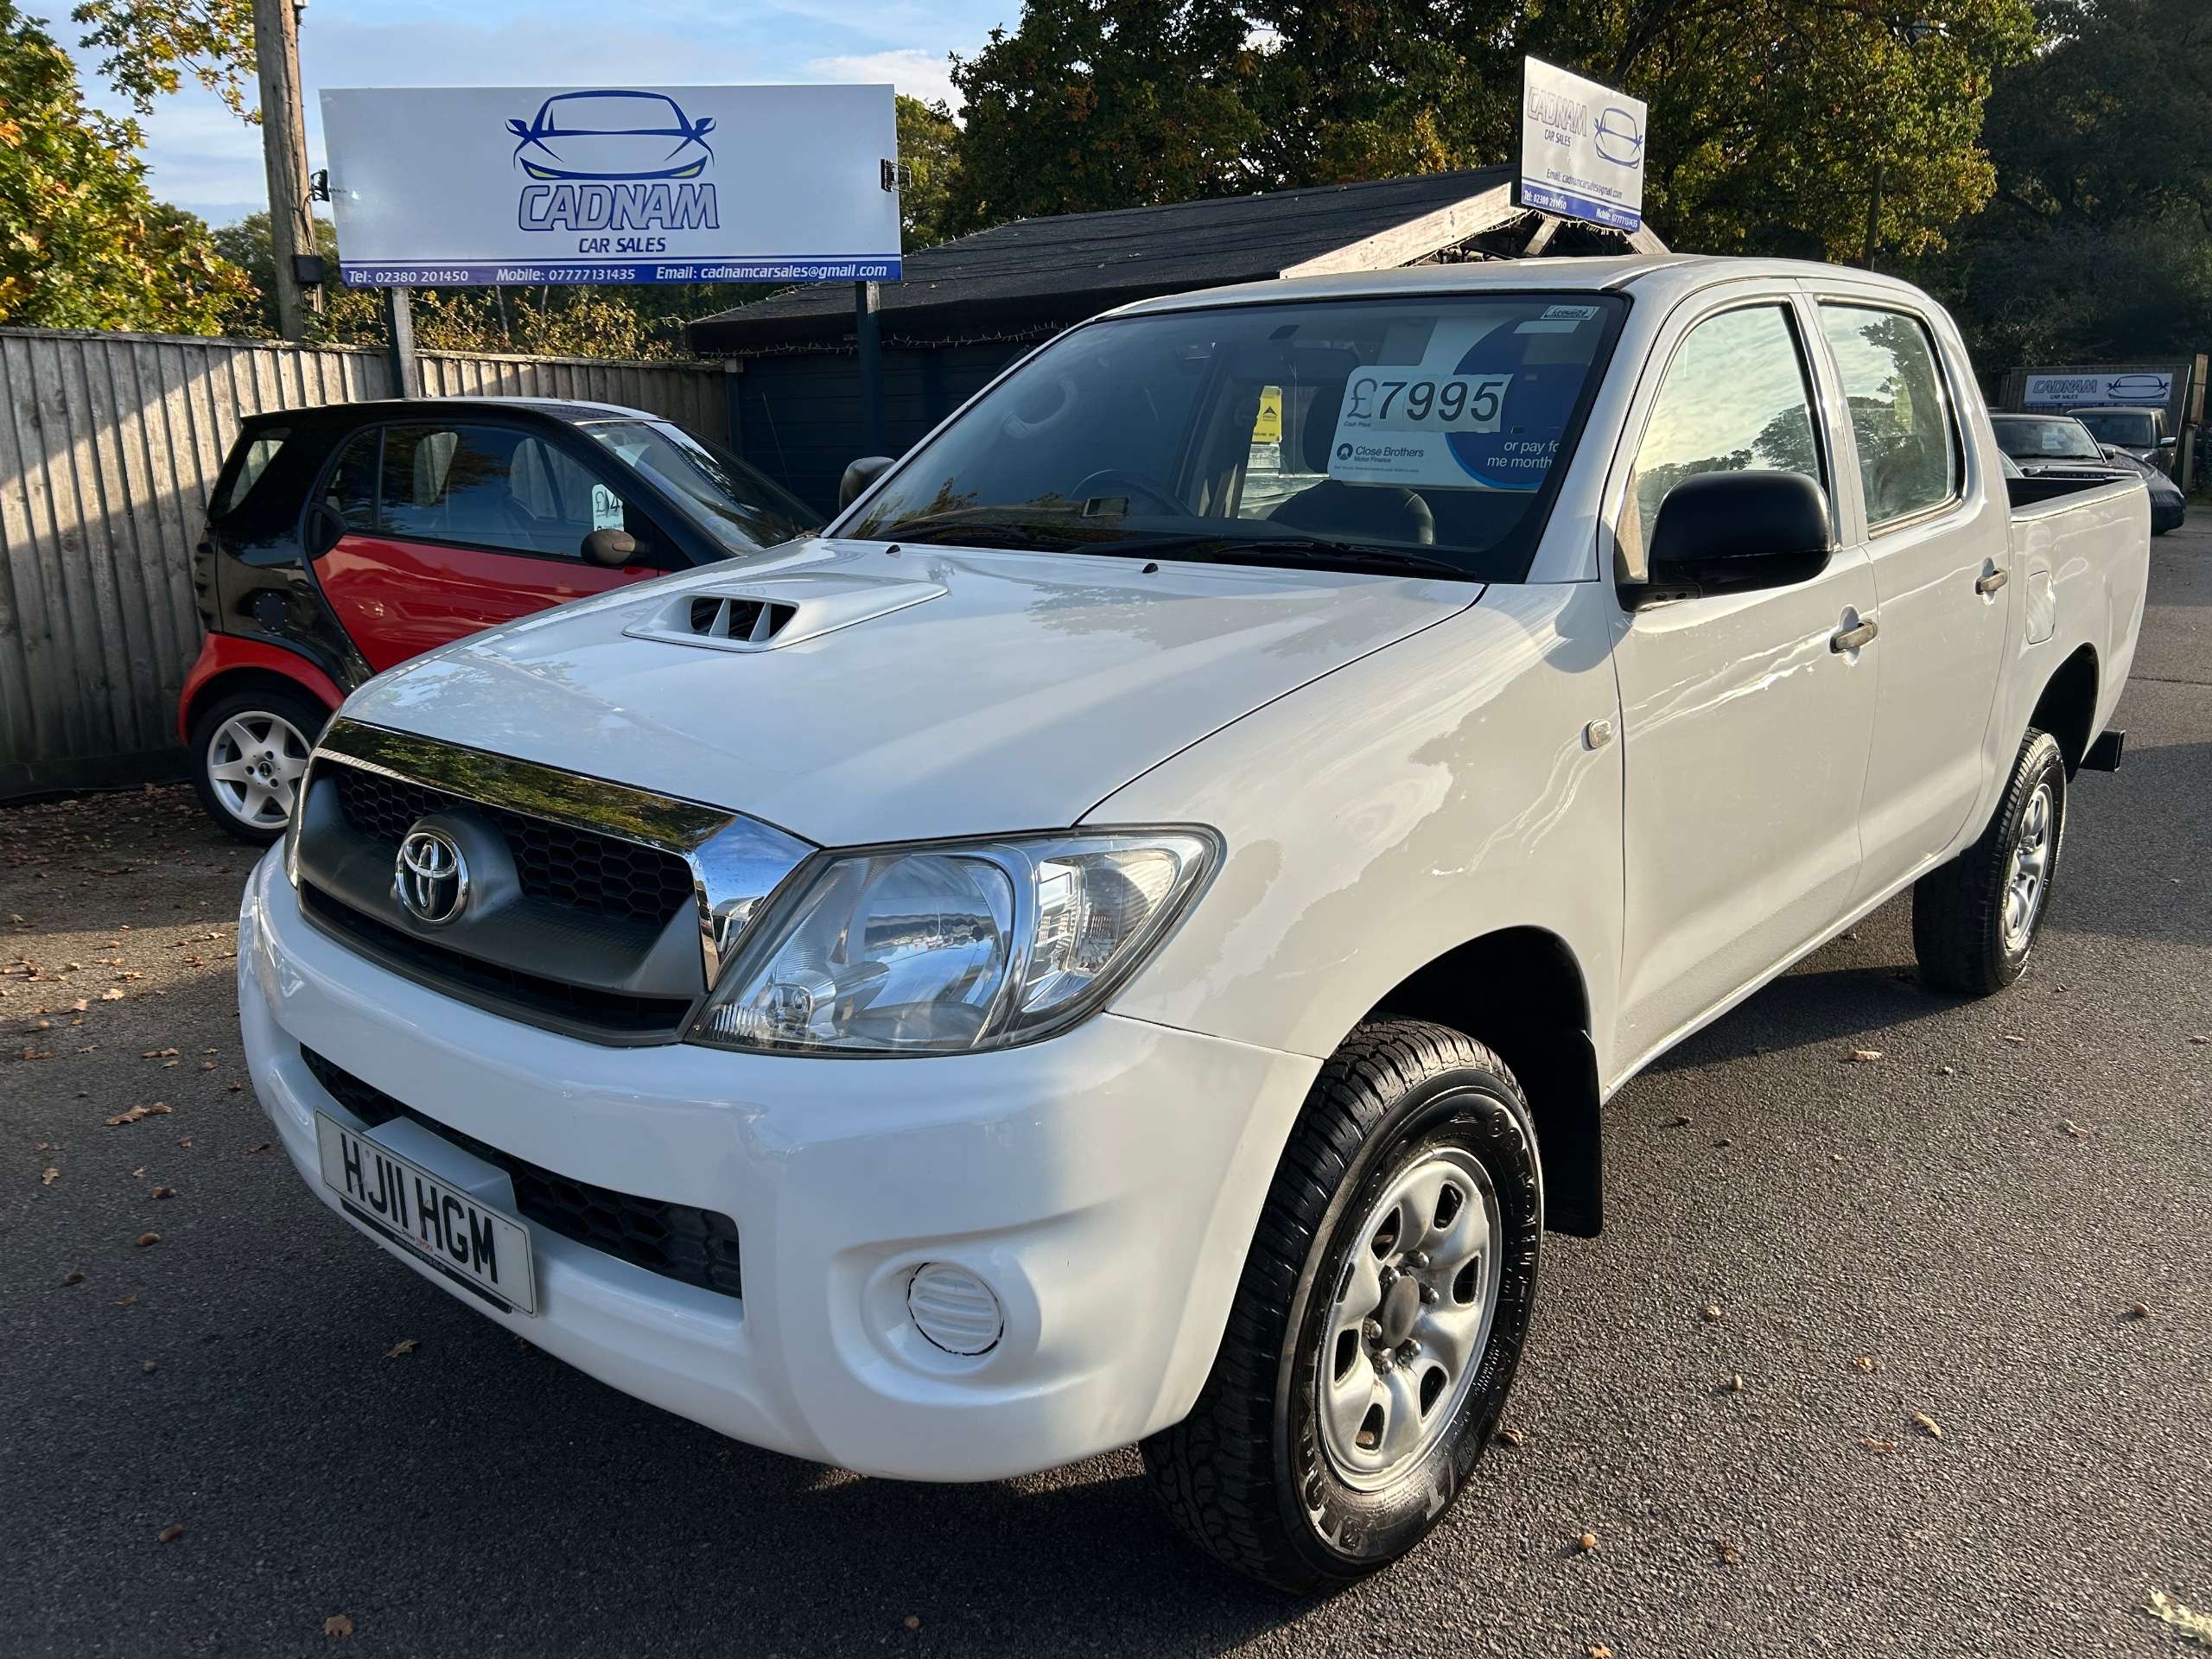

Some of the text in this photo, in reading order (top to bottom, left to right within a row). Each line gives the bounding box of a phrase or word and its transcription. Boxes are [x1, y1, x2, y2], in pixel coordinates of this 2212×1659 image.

[1527, 86, 1587, 137] CADNAM
[1544, 129, 1571, 147] CAR SALES
[1547, 168, 1561, 181] Email:
[1524, 190, 1533, 203] Tel:
[1533, 194, 1549, 207] 02380
[518, 183, 721, 231] CADNAM
[1596, 208, 1611, 222] Mobile:
[579, 237, 666, 253] CAR SALES
[349, 270, 469, 283] Tel: 02380 201450
[496, 269, 635, 282] Mobile: 07777131435
[656, 264, 887, 279] Email: cadnamcarsales@gmail.com
[2032, 379, 2098, 393] CADNAM
[1346, 378, 1504, 422] £7995
[1356, 446, 1425, 457] Close Brothers
[1503, 442, 1519, 451] or
[1520, 442, 1545, 454] pay
[1487, 456, 1507, 467] me
[340, 1133, 499, 1285] HJ11 HGM
